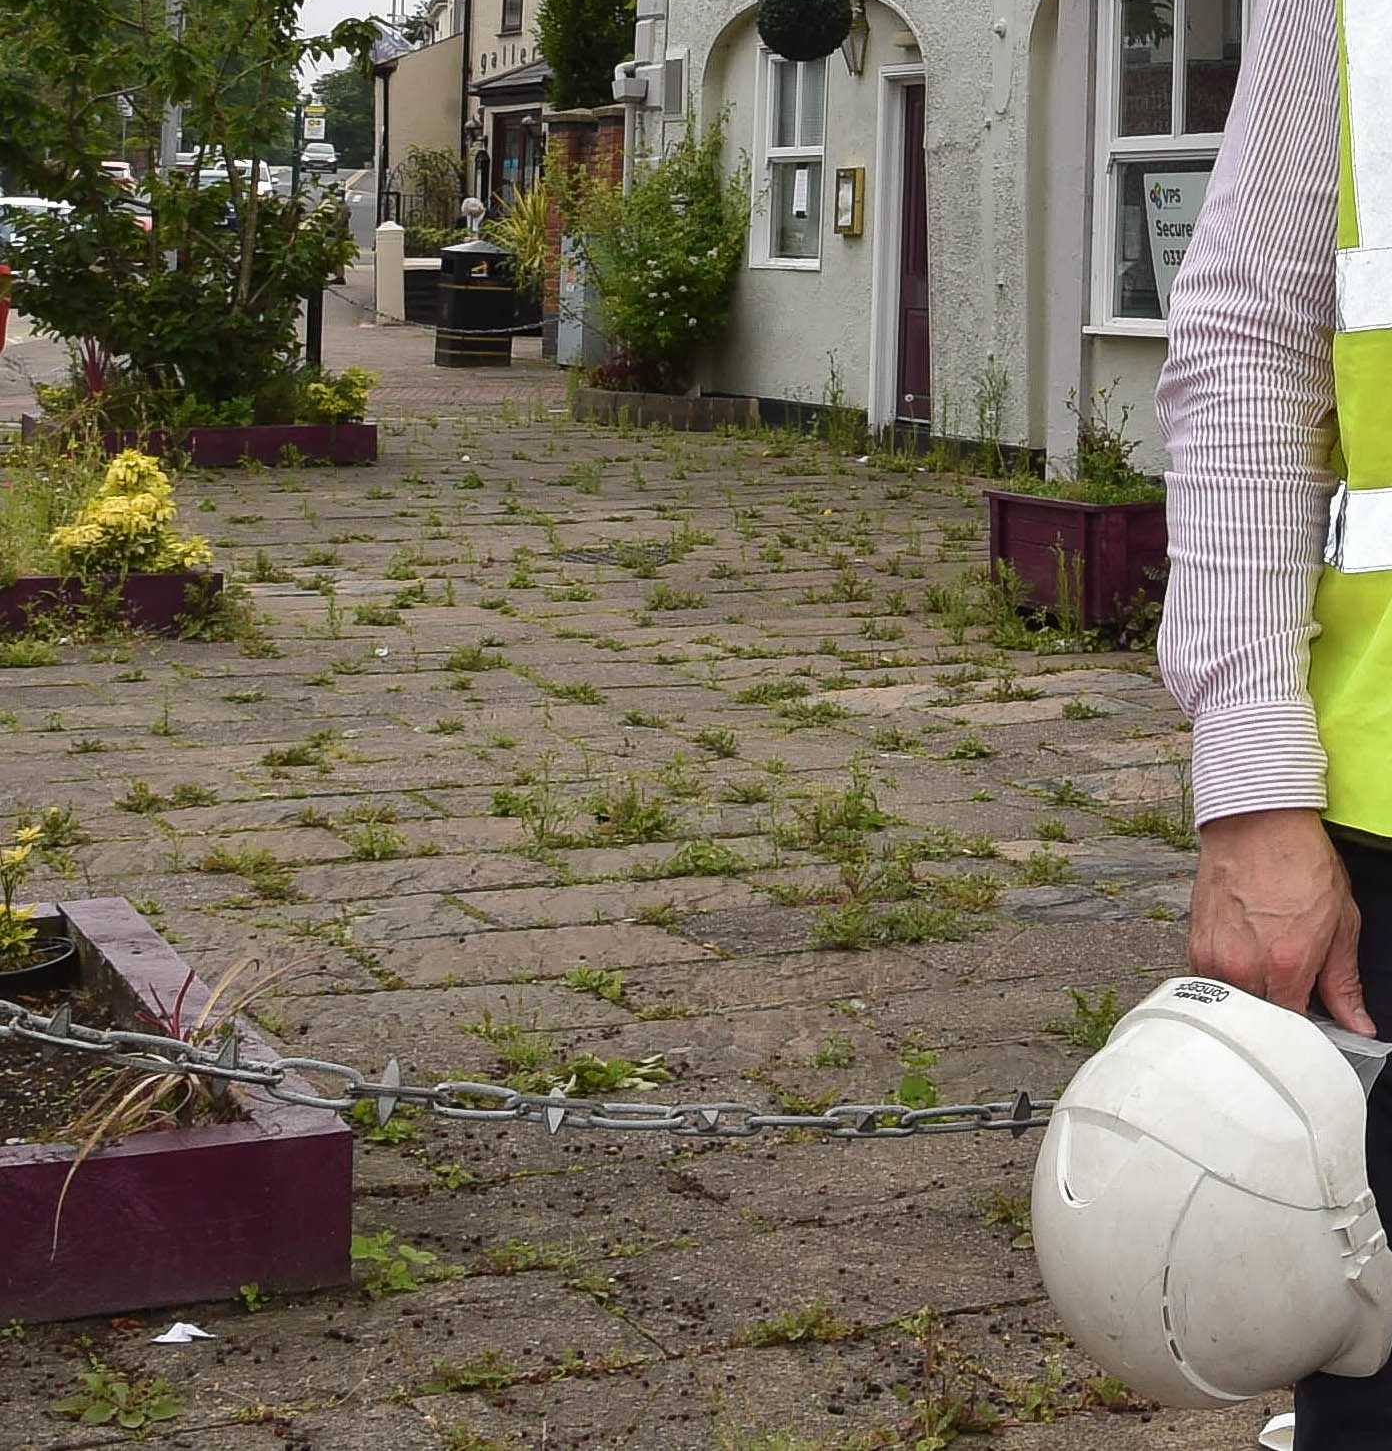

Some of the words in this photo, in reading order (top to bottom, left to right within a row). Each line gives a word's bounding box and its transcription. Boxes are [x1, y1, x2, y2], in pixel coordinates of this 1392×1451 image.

[480, 43, 541, 76] galler
[1162, 187, 1182, 204] VPS
[1155, 219, 1196, 238] Secure
